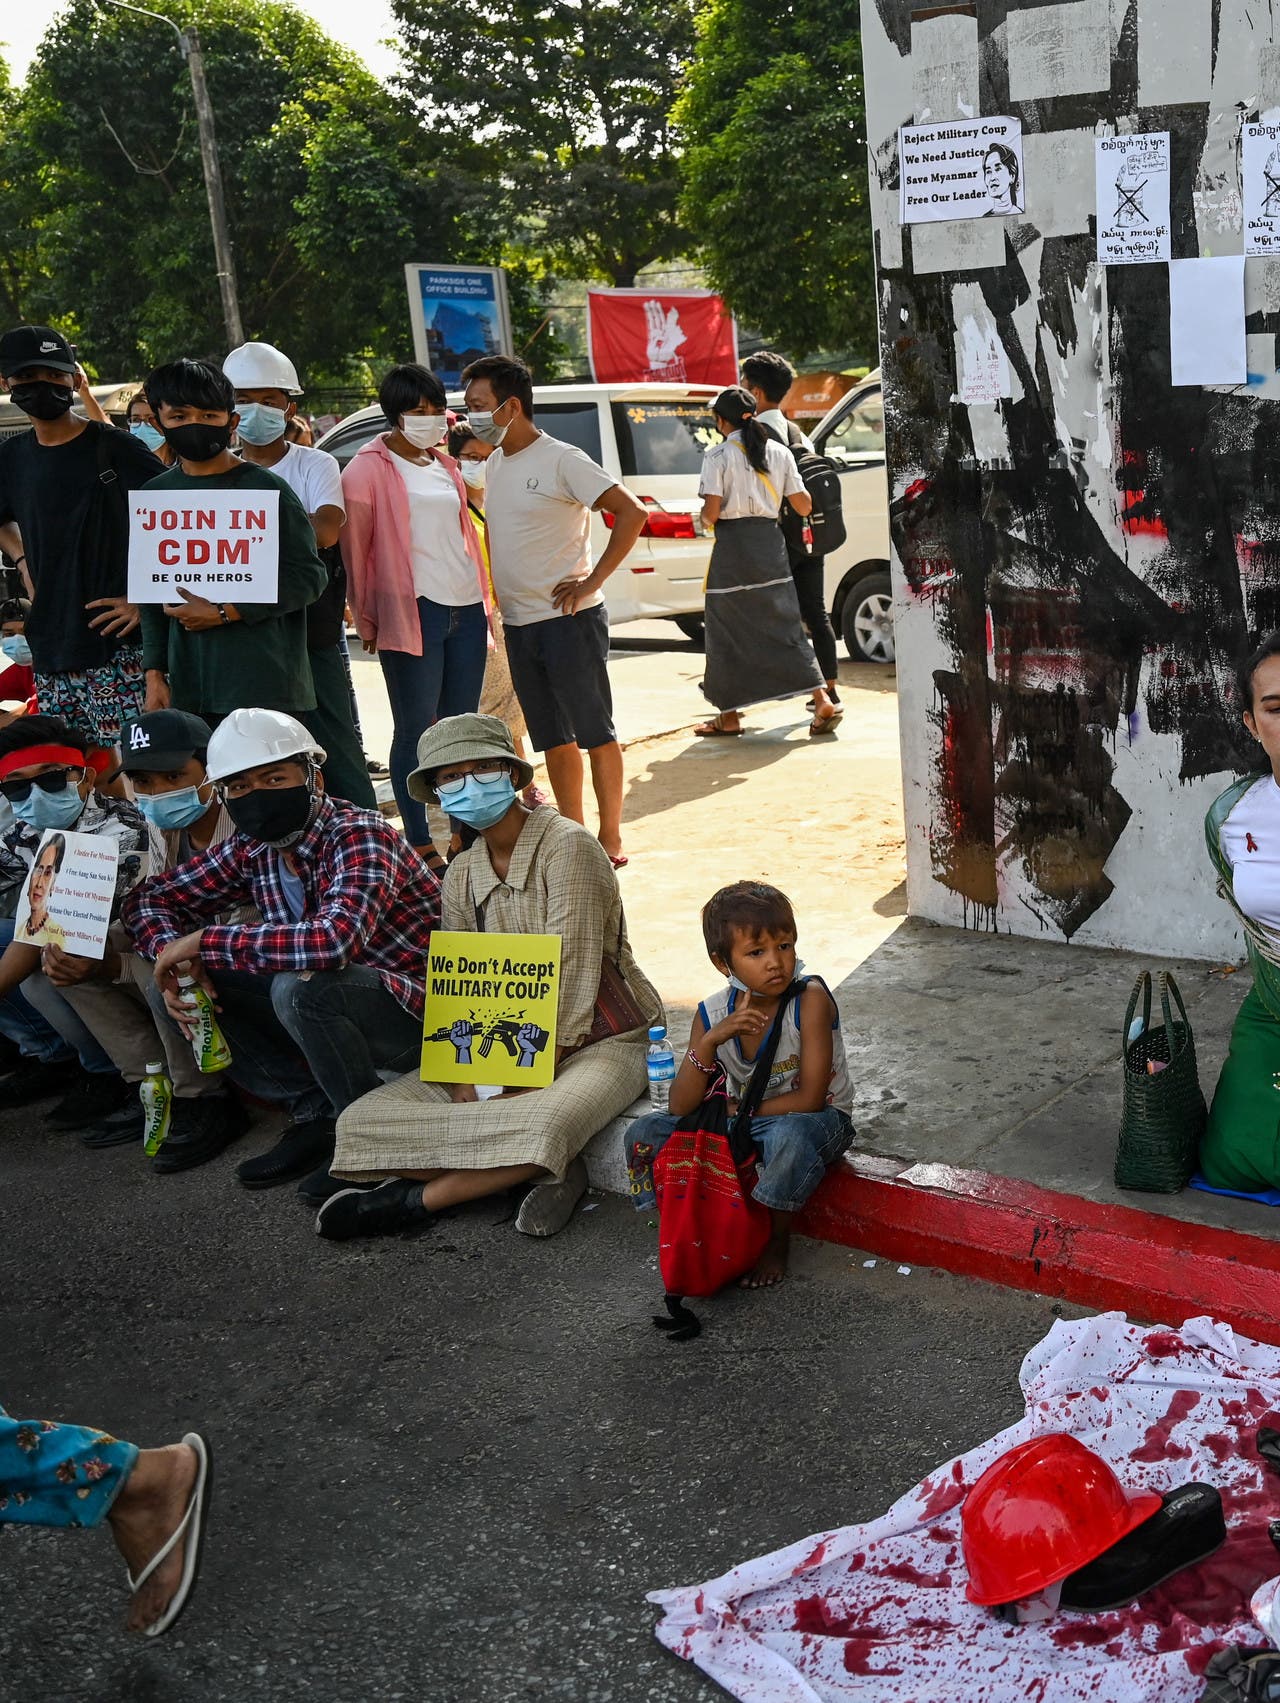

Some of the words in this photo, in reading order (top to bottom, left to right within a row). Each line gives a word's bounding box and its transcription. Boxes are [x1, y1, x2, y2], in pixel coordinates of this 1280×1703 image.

[904, 133, 935, 145] Reject
[938, 129, 979, 140] Military
[982, 126, 1007, 136] Coup
[905, 156, 920, 164] We
[922, 152, 946, 162] Need
[949, 148, 984, 160] Justice
[906, 175, 928, 185] Save
[931, 171, 978, 184] Myanmar
[907, 196, 928, 205] Free
[932, 194, 950, 202] Our
[953, 190, 987, 201] Leader
[426, 286, 452, 294] OFFICE
[454, 287, 488, 295] BUILDING
[429, 277, 465, 286] PARKSIDE
[467, 278, 482, 286] ONE
[229, 510, 266, 530] IN
[152, 574, 168, 582] BE
[174, 574, 201, 582] OUR
[207, 573, 252, 582] HEROS
[130, 723, 150, 750] LA
[432, 956, 453, 973] We
[502, 958, 554, 982] Accept
[432, 978, 502, 998] MILITARY
[506, 981, 550, 1000] COUP
[202, 1004, 212, 1054] Royal-D
[149, 1095, 165, 1140] Royal-D
